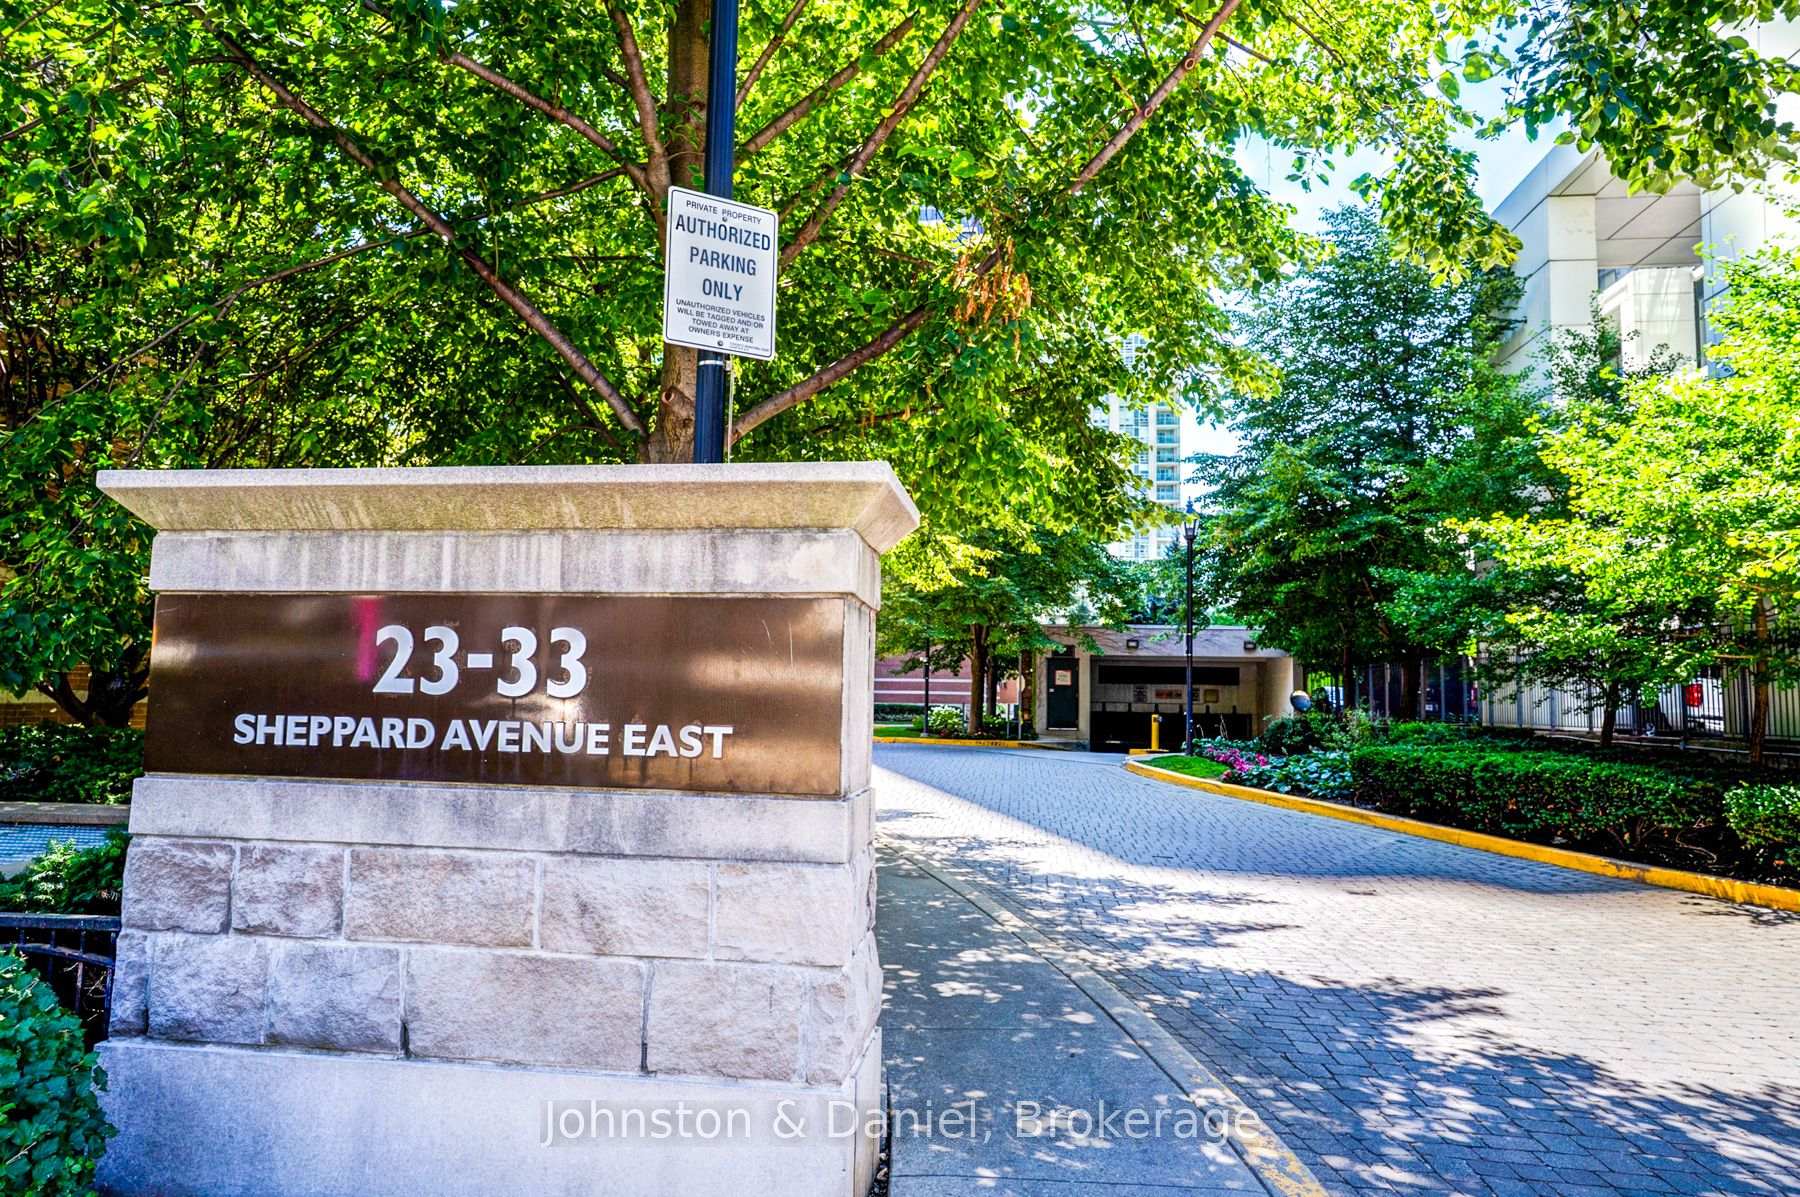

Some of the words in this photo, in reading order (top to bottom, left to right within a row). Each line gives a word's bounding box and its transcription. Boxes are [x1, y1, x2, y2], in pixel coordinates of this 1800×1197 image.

[686, 200, 717, 214] PRIVATE
[722, 208, 762, 224] PROPERTY
[675, 214, 771, 251] AUTHORIZED
[689, 246, 757, 276] PARKING
[702, 278, 743, 301] ONLY
[676, 298, 731, 315] UNAUTHORIZED
[732, 310, 765, 321] VEHICLES
[677, 307, 694, 317] WILL
[707, 313, 736, 324] TAGGED
[737, 319, 752, 327] AND
[692, 318, 718, 328] TOWED
[719, 322, 741, 332] AWAY
[722, 331, 754, 343] EXPENSE
[372, 624, 588, 698] 23-33
[233, 713, 435, 750] SHEPPARD
[440, 719, 610, 756] AVENUE
[622, 724, 734, 759] EAST
